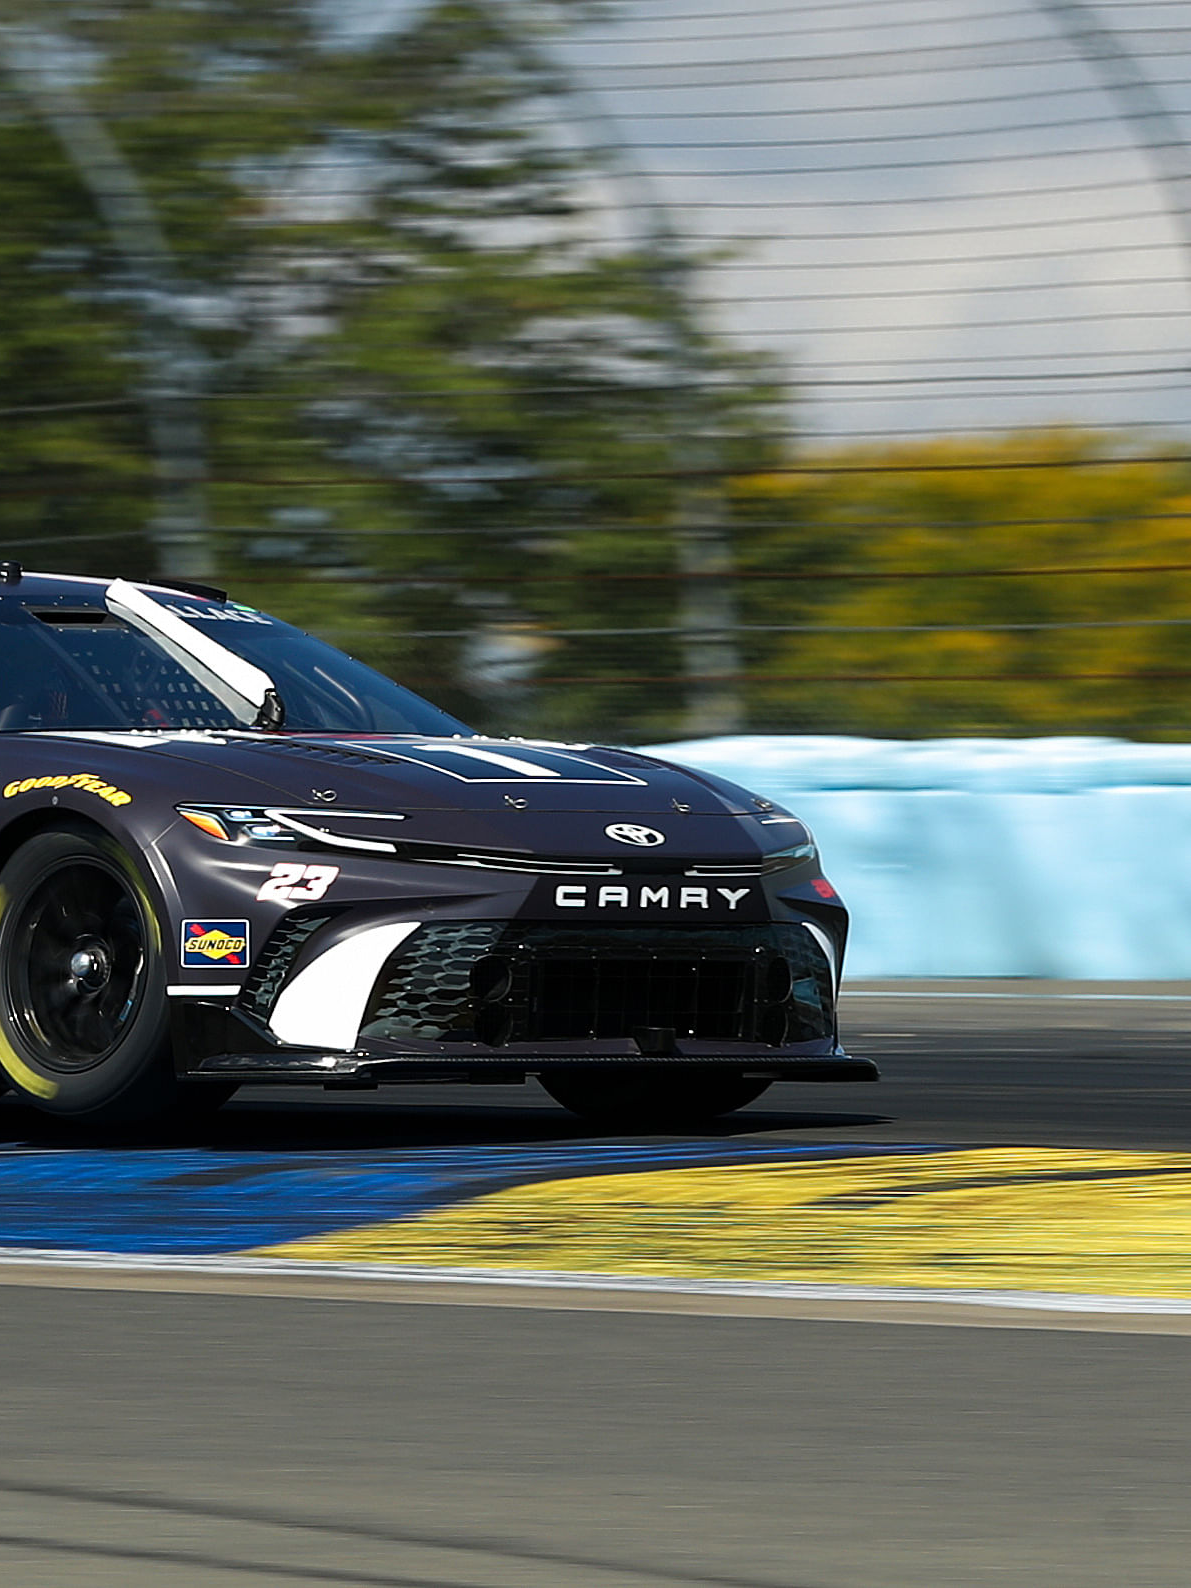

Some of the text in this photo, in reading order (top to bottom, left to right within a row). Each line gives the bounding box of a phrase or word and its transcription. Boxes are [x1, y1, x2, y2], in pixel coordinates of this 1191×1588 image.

[3, 773, 132, 806] GOODYEAR
[255, 862, 340, 901] 23
[555, 885, 751, 910] CAMRY
[188, 939, 242, 951] SUNOCO
